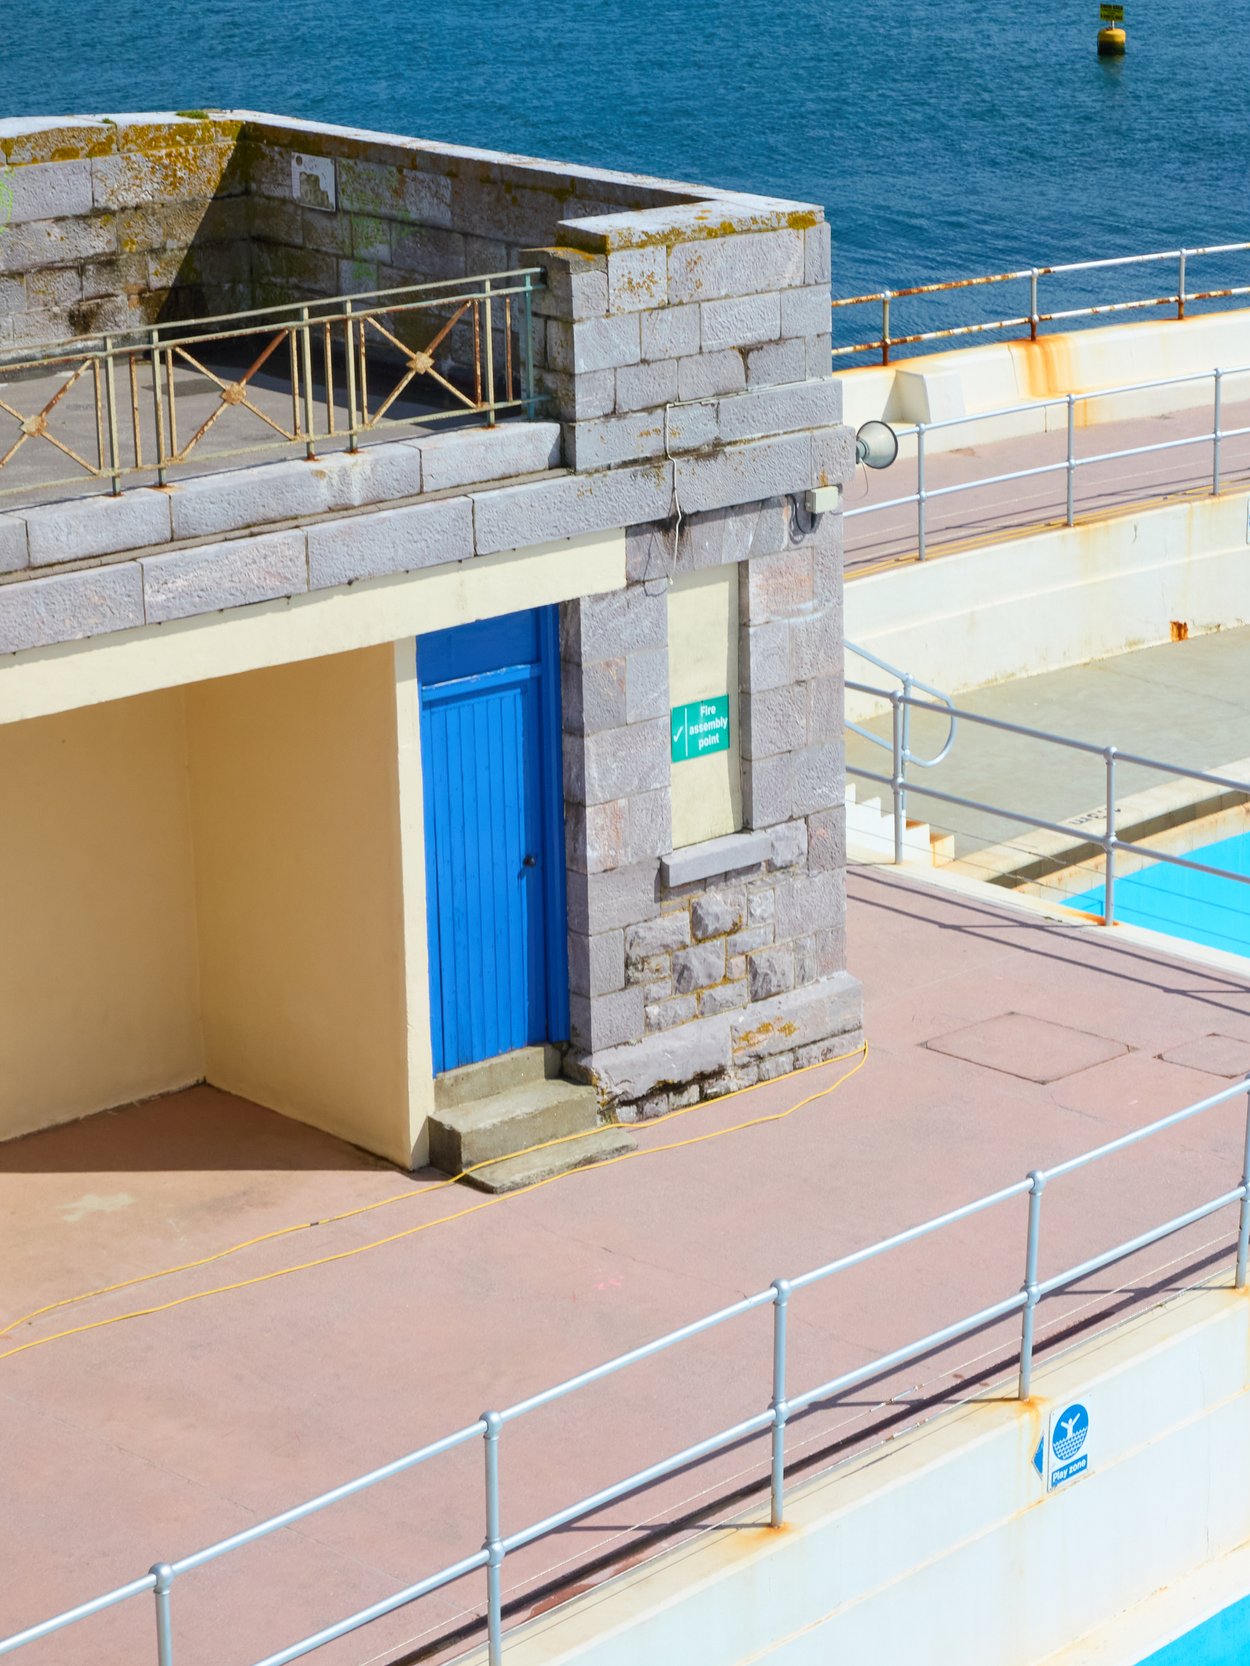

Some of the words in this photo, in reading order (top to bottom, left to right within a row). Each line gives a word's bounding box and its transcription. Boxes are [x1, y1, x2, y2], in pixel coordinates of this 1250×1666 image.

[700, 705, 716, 717] Fire
[689, 716, 728, 735] assembly
[698, 732, 719, 751] point
[1052, 1468, 1068, 1483] Play
[1069, 1459, 1087, 1474] zone
